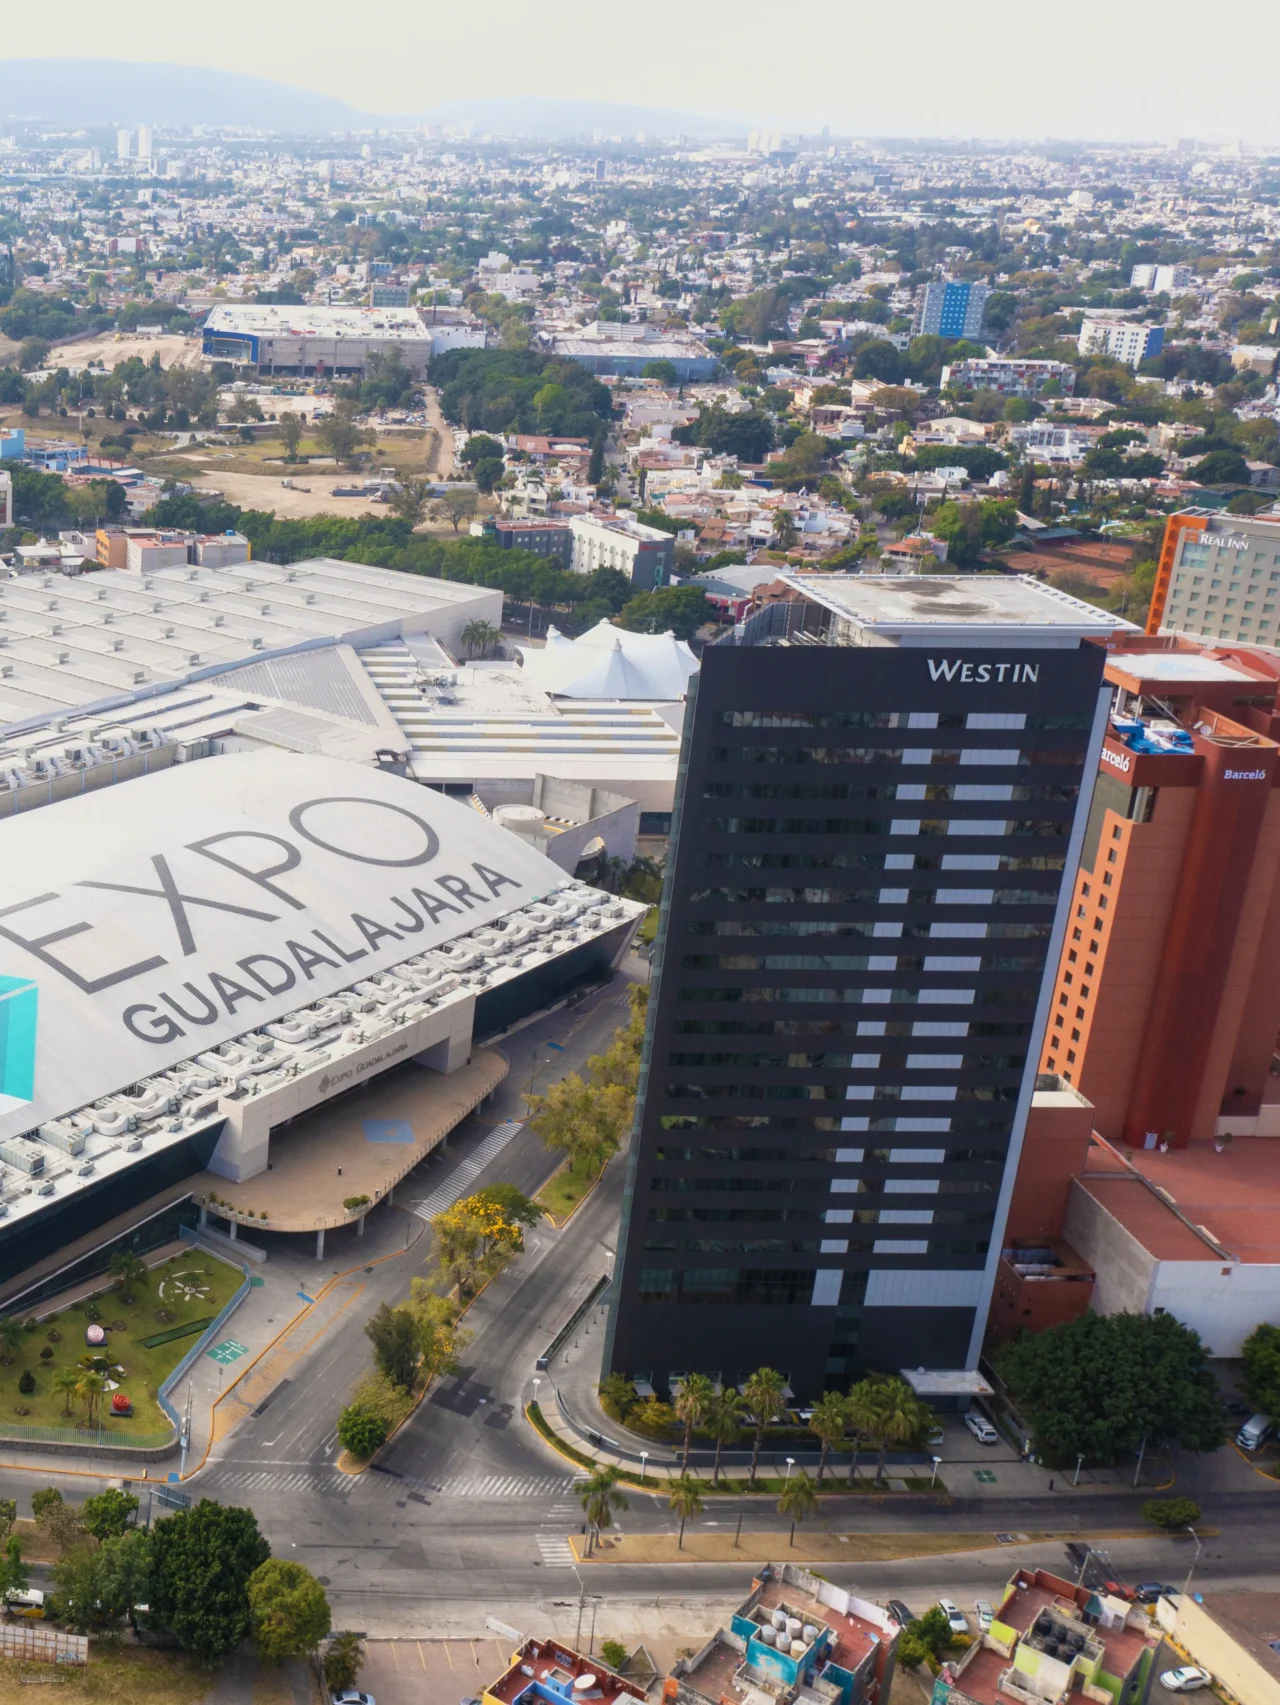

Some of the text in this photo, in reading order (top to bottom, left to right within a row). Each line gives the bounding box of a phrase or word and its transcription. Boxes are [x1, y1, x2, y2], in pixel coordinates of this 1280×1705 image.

[1200, 534, 1249, 550] REAL INN
[927, 658, 1040, 682] WESTIN
[1101, 748, 1130, 773] arceló
[1223, 769, 1266, 780] Barceló
[122, 862, 523, 1045] GUADALAJARA
[330, 1042, 409, 1087] EXPO GUADALAJARA
